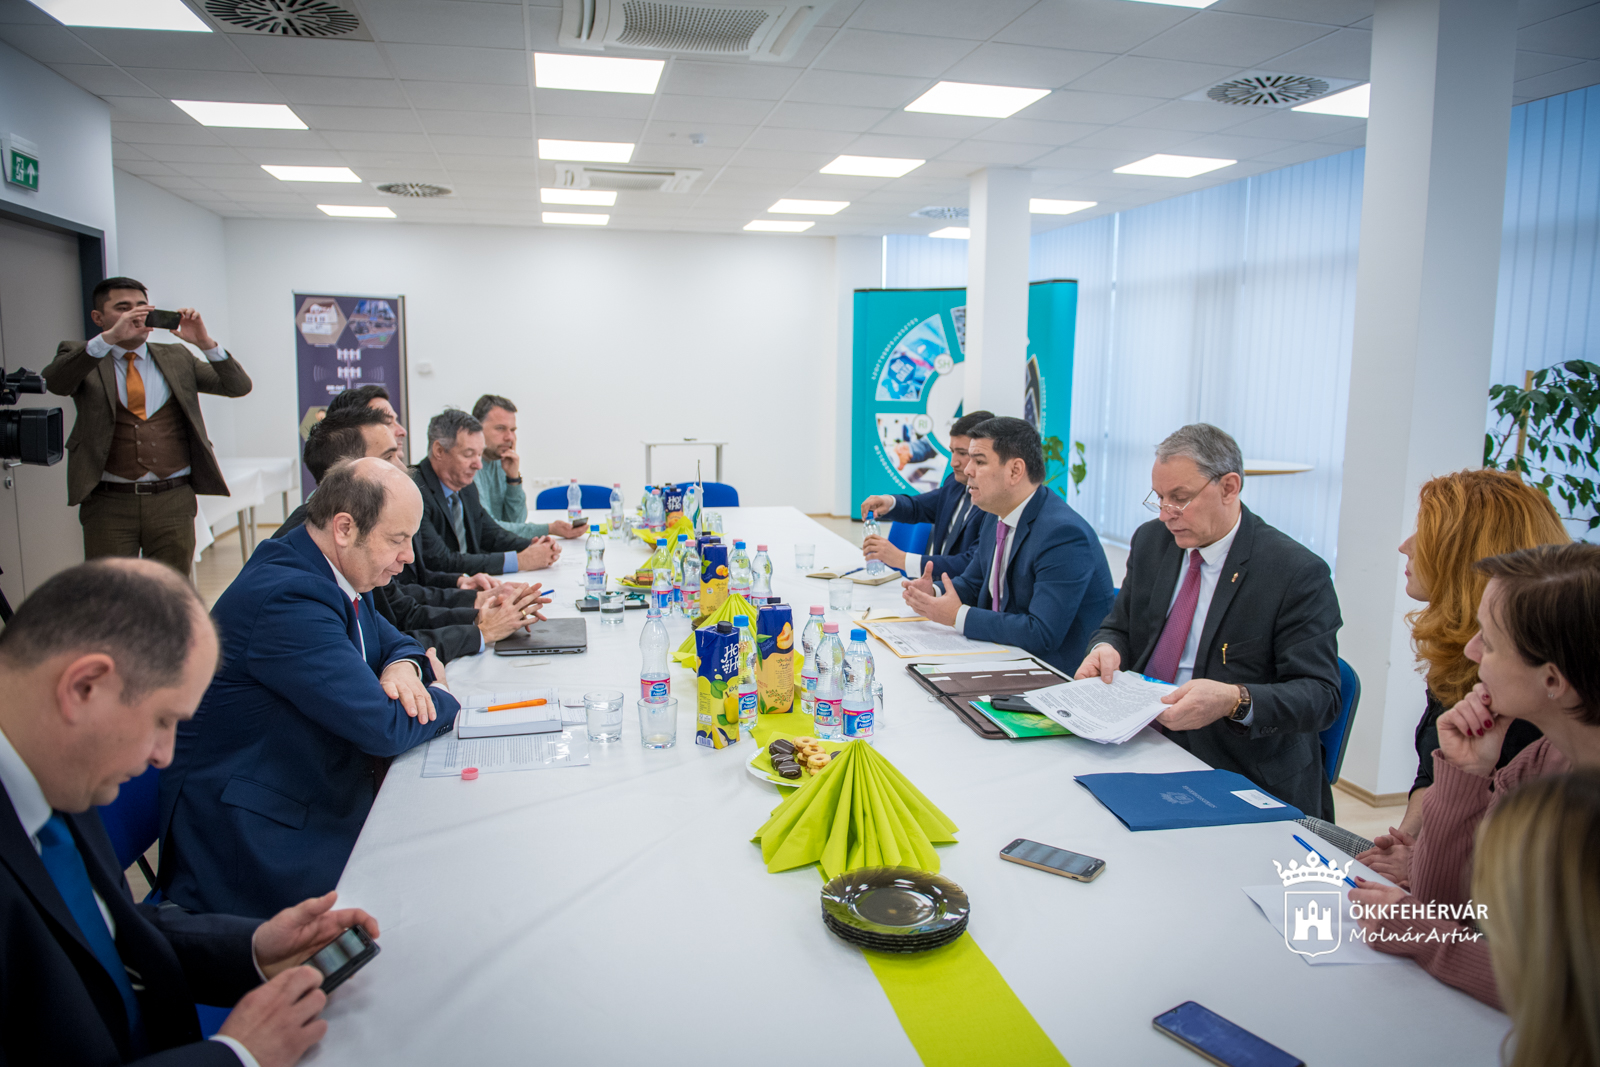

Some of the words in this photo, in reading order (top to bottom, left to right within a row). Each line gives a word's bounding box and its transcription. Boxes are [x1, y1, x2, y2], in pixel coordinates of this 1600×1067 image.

[890, 358, 905, 374] BIG
[896, 363, 915, 383] DATA
[937, 359, 951, 369] SH
[720, 642, 739, 663] He
